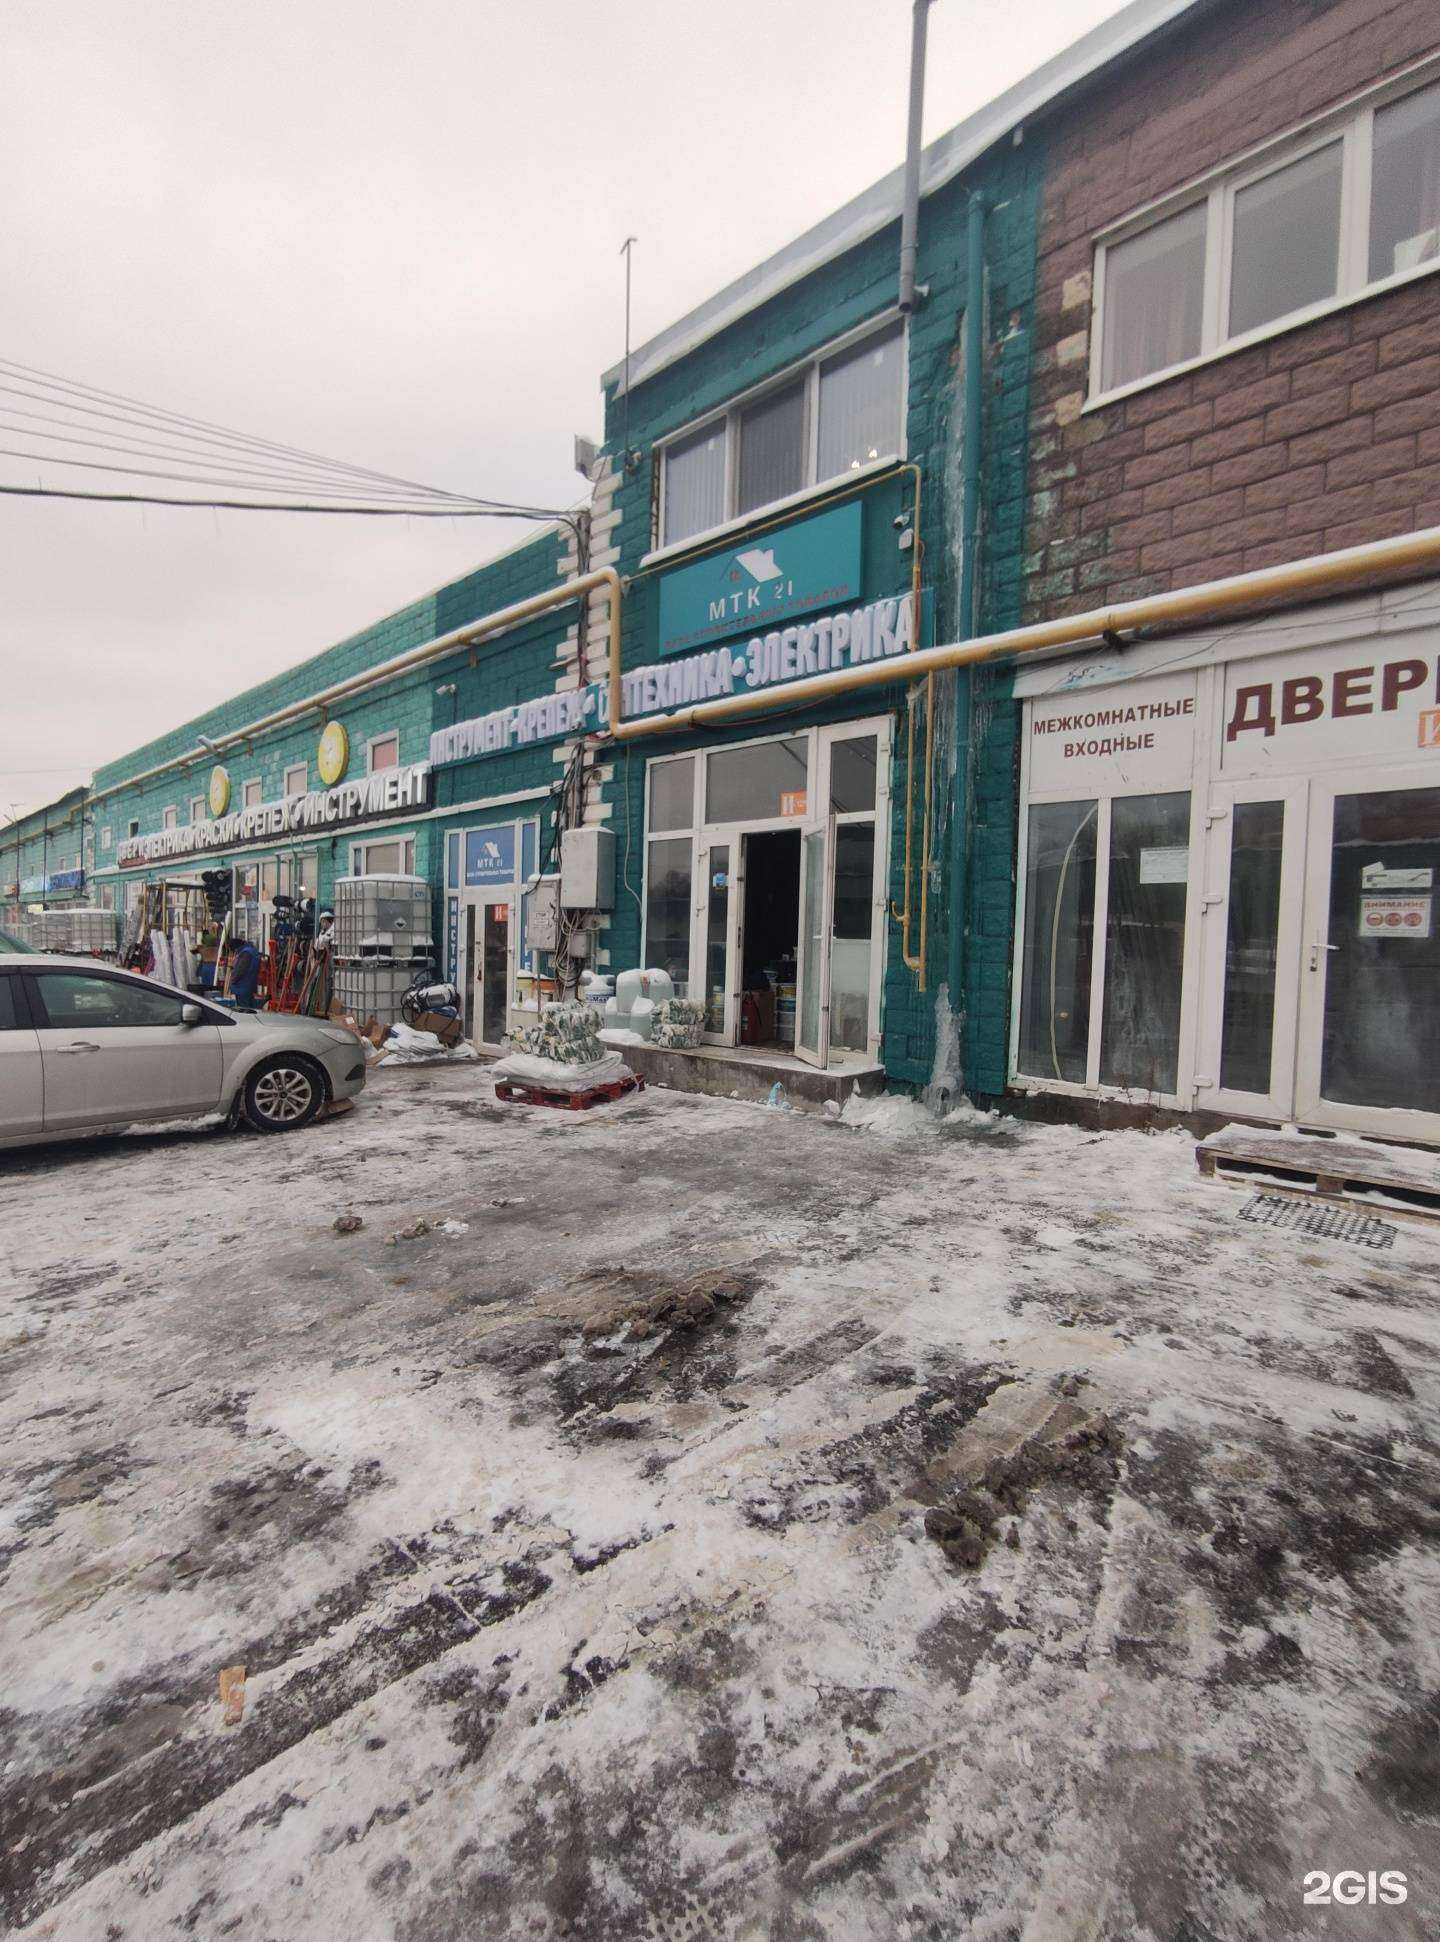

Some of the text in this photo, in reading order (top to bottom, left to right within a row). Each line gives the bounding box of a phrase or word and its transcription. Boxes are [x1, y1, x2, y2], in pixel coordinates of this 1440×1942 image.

[709, 586, 760, 621] МТК
[598, 649, 734, 723] СНТЕХНИКА
[746, 595, 915, 687] ЭЛЕКТРИКА
[1033, 698, 1195, 736] МЕЖКОМНАТНЫЕ
[1226, 655, 1440, 742] ДВЕР
[1063, 732, 1156, 758] ВХОДНЫЕ
[303, 767, 428, 826] ИНСТРУМЕНТ
